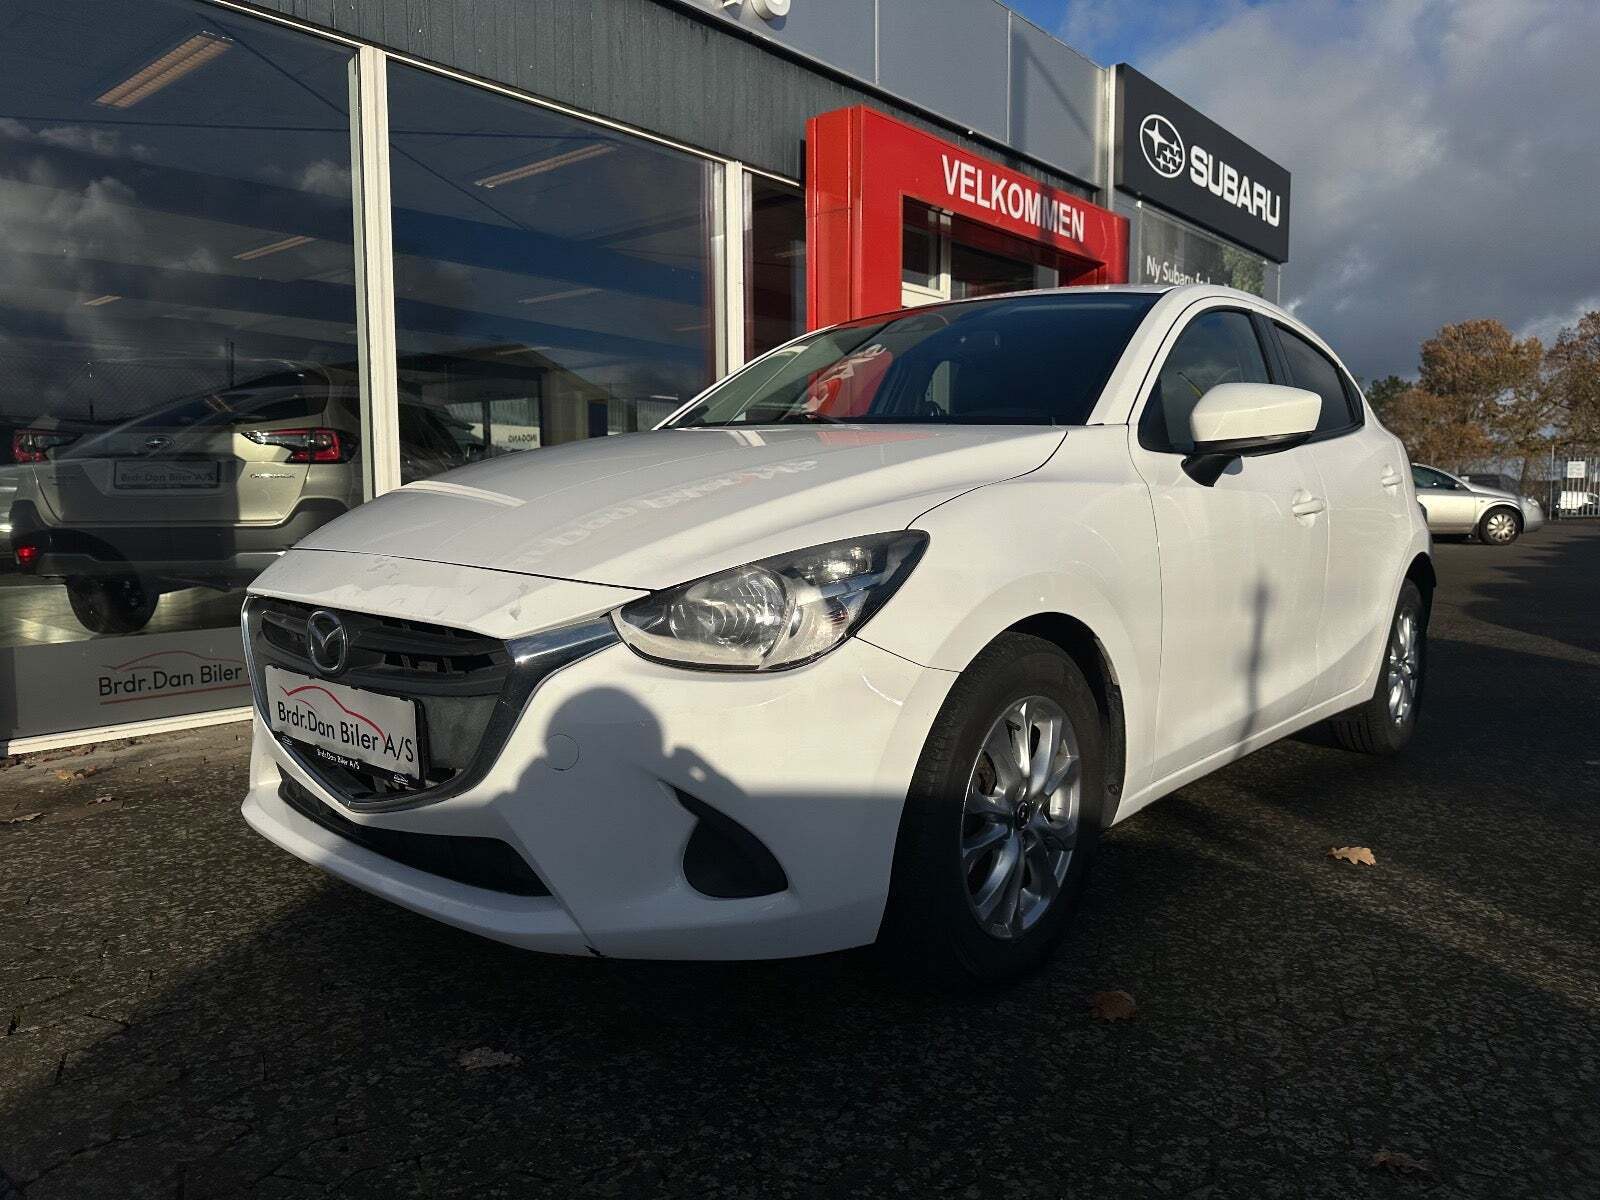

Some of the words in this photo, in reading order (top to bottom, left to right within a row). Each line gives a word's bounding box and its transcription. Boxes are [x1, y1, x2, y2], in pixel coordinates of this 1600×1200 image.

[941, 153, 1085, 243] VELKOMMEN
[1190, 145, 1281, 228] SUBARU
[1146, 255, 1161, 284] Ny
[98, 670, 194, 697] Brdr.Dan
[200, 664, 243, 684] Biler
[278, 701, 336, 740] Brdr.Dan
[340, 720, 379, 752] Biler
[383, 732, 414, 763] A/S
